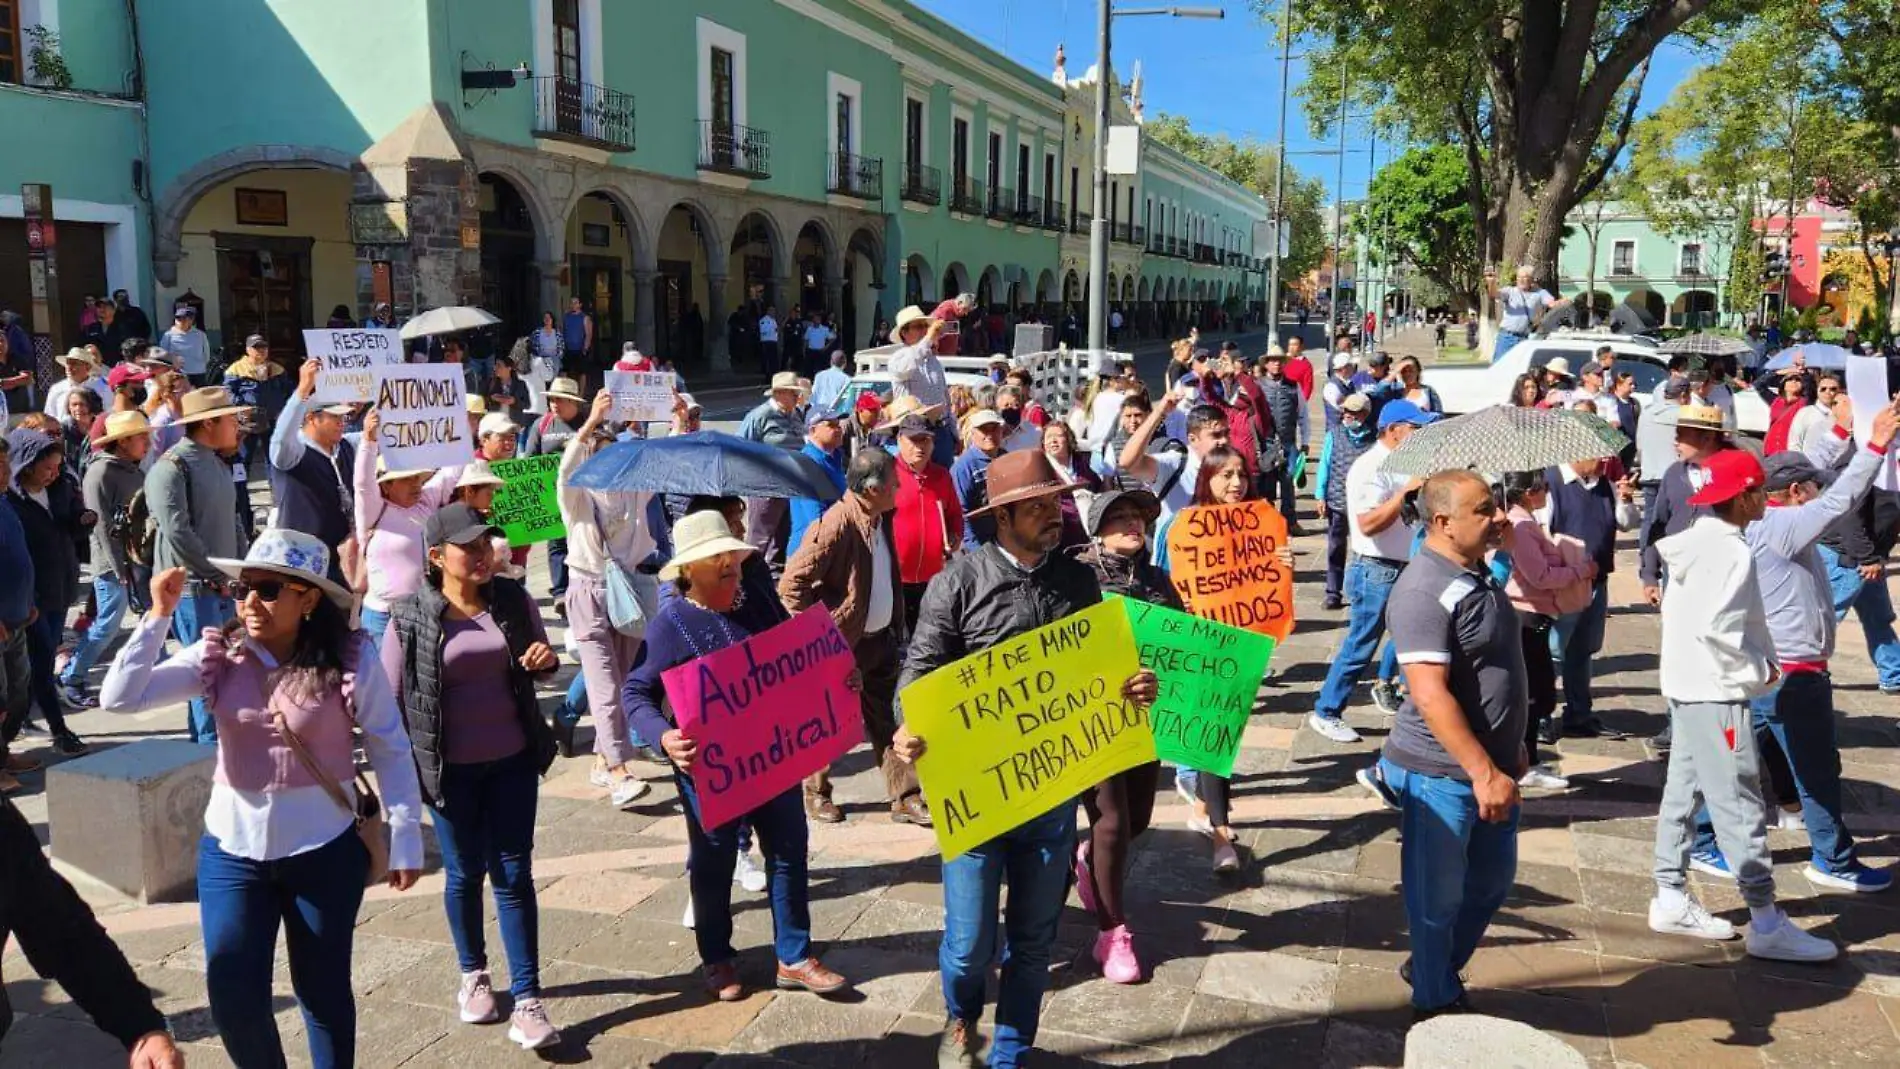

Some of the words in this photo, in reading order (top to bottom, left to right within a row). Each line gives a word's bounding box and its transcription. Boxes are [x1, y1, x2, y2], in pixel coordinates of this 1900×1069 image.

[332, 332, 389, 351] RESPETO
[328, 353, 373, 371] NUESTRA
[376, 376, 461, 411] AUTONOMIA
[381, 416, 462, 449] SINDICAL
[1188, 503, 1260, 538] SOMOS
[1205, 547, 1225, 567] DE
[1232, 535, 1276, 565] MAYO
[1195, 559, 1282, 595] ESTAMOS
[1161, 618, 1184, 634] DE
[1002, 643, 1031, 671] DE
[1040, 618, 1091, 658] MAYO
[950, 670, 1056, 730] TRATO
[1016, 677, 1106, 736] DIGNO
[1199, 689, 1243, 714] UNA
[943, 788, 981, 835] AL
[982, 695, 1150, 801] TRABAJADOR
